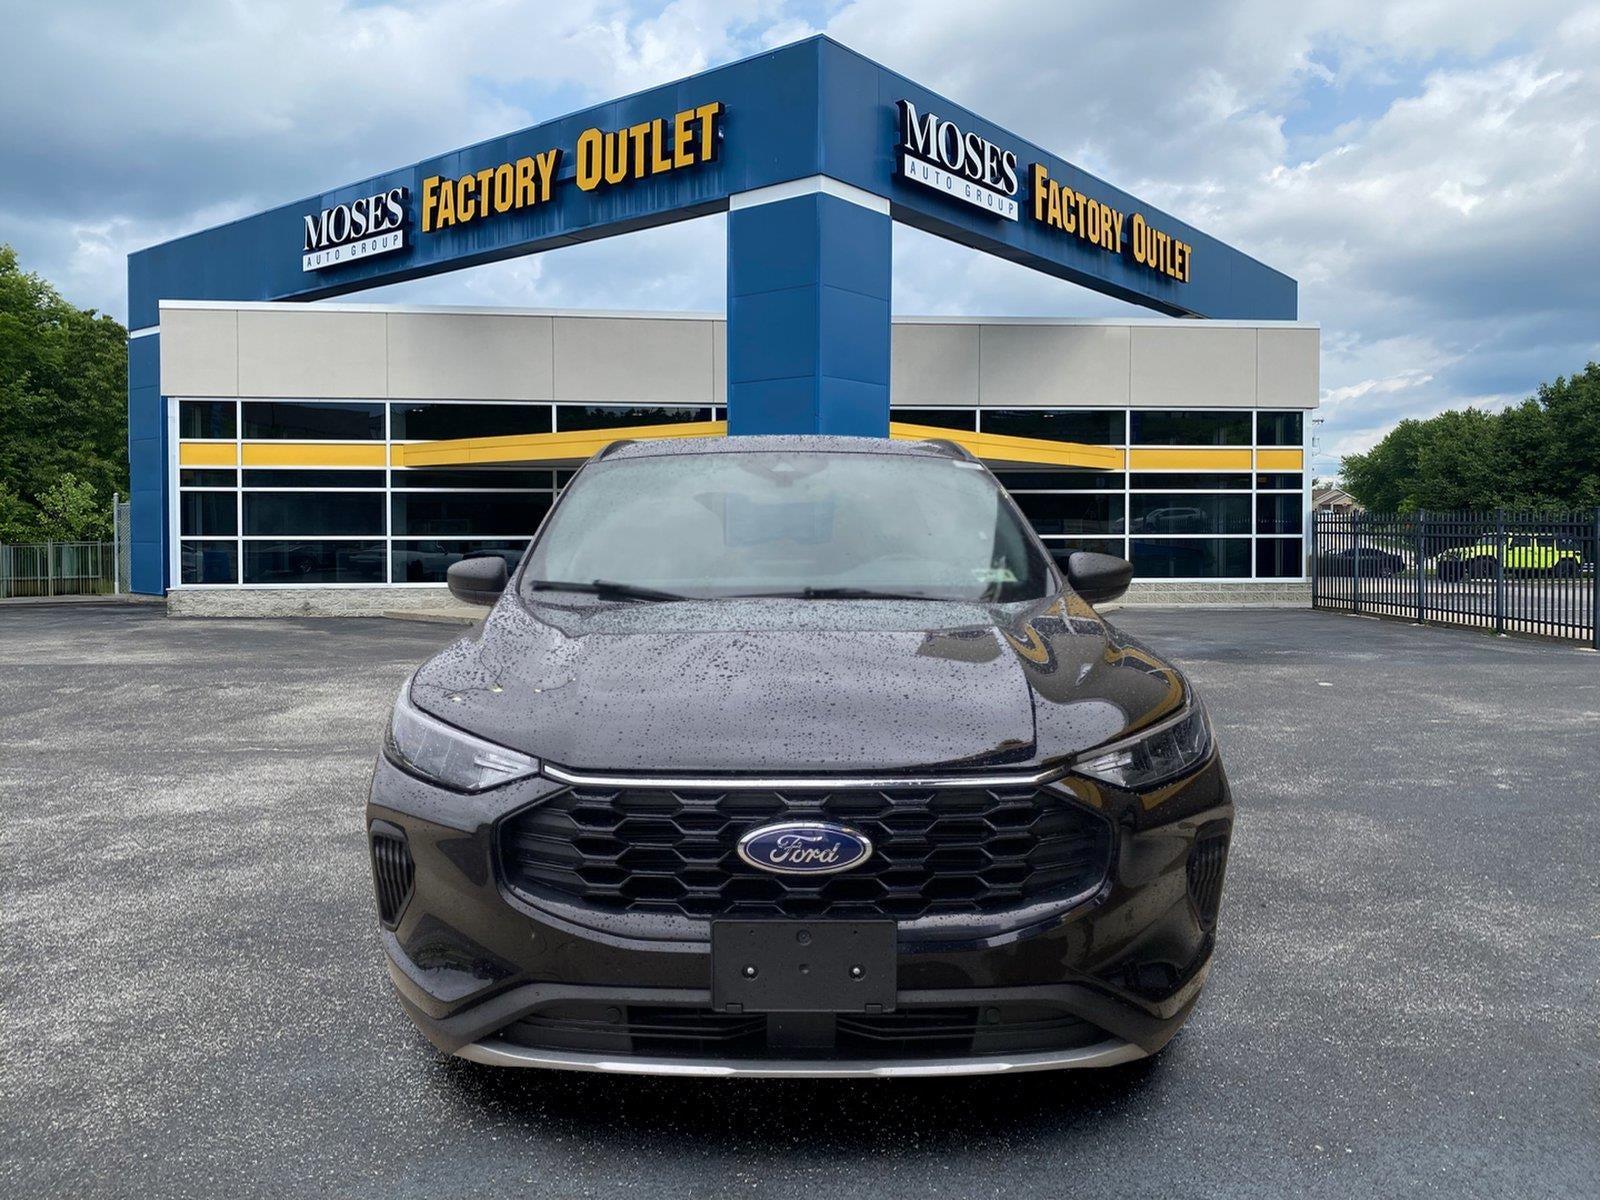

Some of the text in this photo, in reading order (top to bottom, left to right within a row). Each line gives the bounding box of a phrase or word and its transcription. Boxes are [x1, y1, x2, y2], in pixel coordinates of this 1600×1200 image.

[903, 100, 1018, 196] MOSES
[910, 160, 1015, 215] AUTO GROUP
[303, 187, 404, 252] MOSES
[306, 234, 400, 267] AUTO GROUP
[769, 834, 841, 863] Ford
